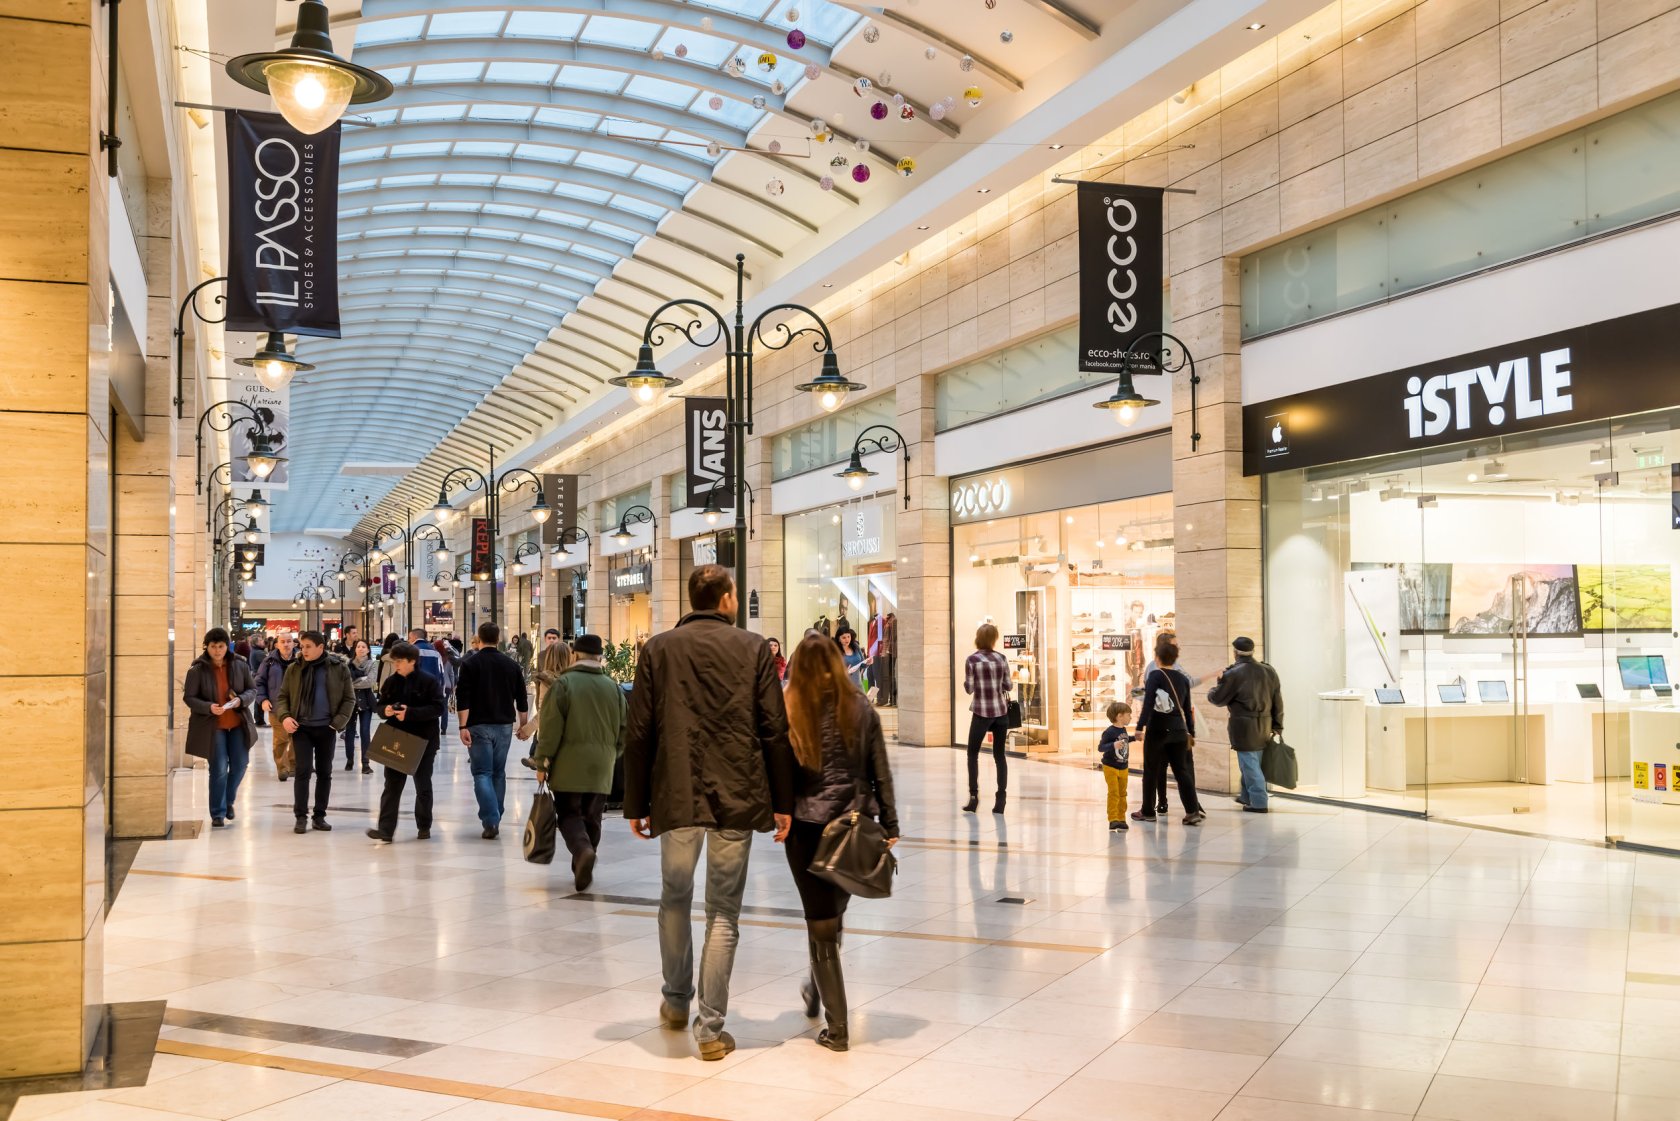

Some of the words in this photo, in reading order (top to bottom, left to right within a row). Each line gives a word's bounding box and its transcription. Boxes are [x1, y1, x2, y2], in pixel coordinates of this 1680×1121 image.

[254, 137, 300, 272] PASSO
[304, 143, 314, 243] ACCESSORIES
[304, 248, 314, 257] &
[1107, 198, 1138, 333] ecco
[256, 280, 299, 308] IL
[304, 261, 314, 309] SHOES
[245, 385, 276, 393] GUES
[1403, 347, 1573, 439] iSTYLE
[693, 409, 727, 495] VANS
[475, 520, 490, 572] REPLA
[1111, 636, 1124, 648] 20%
